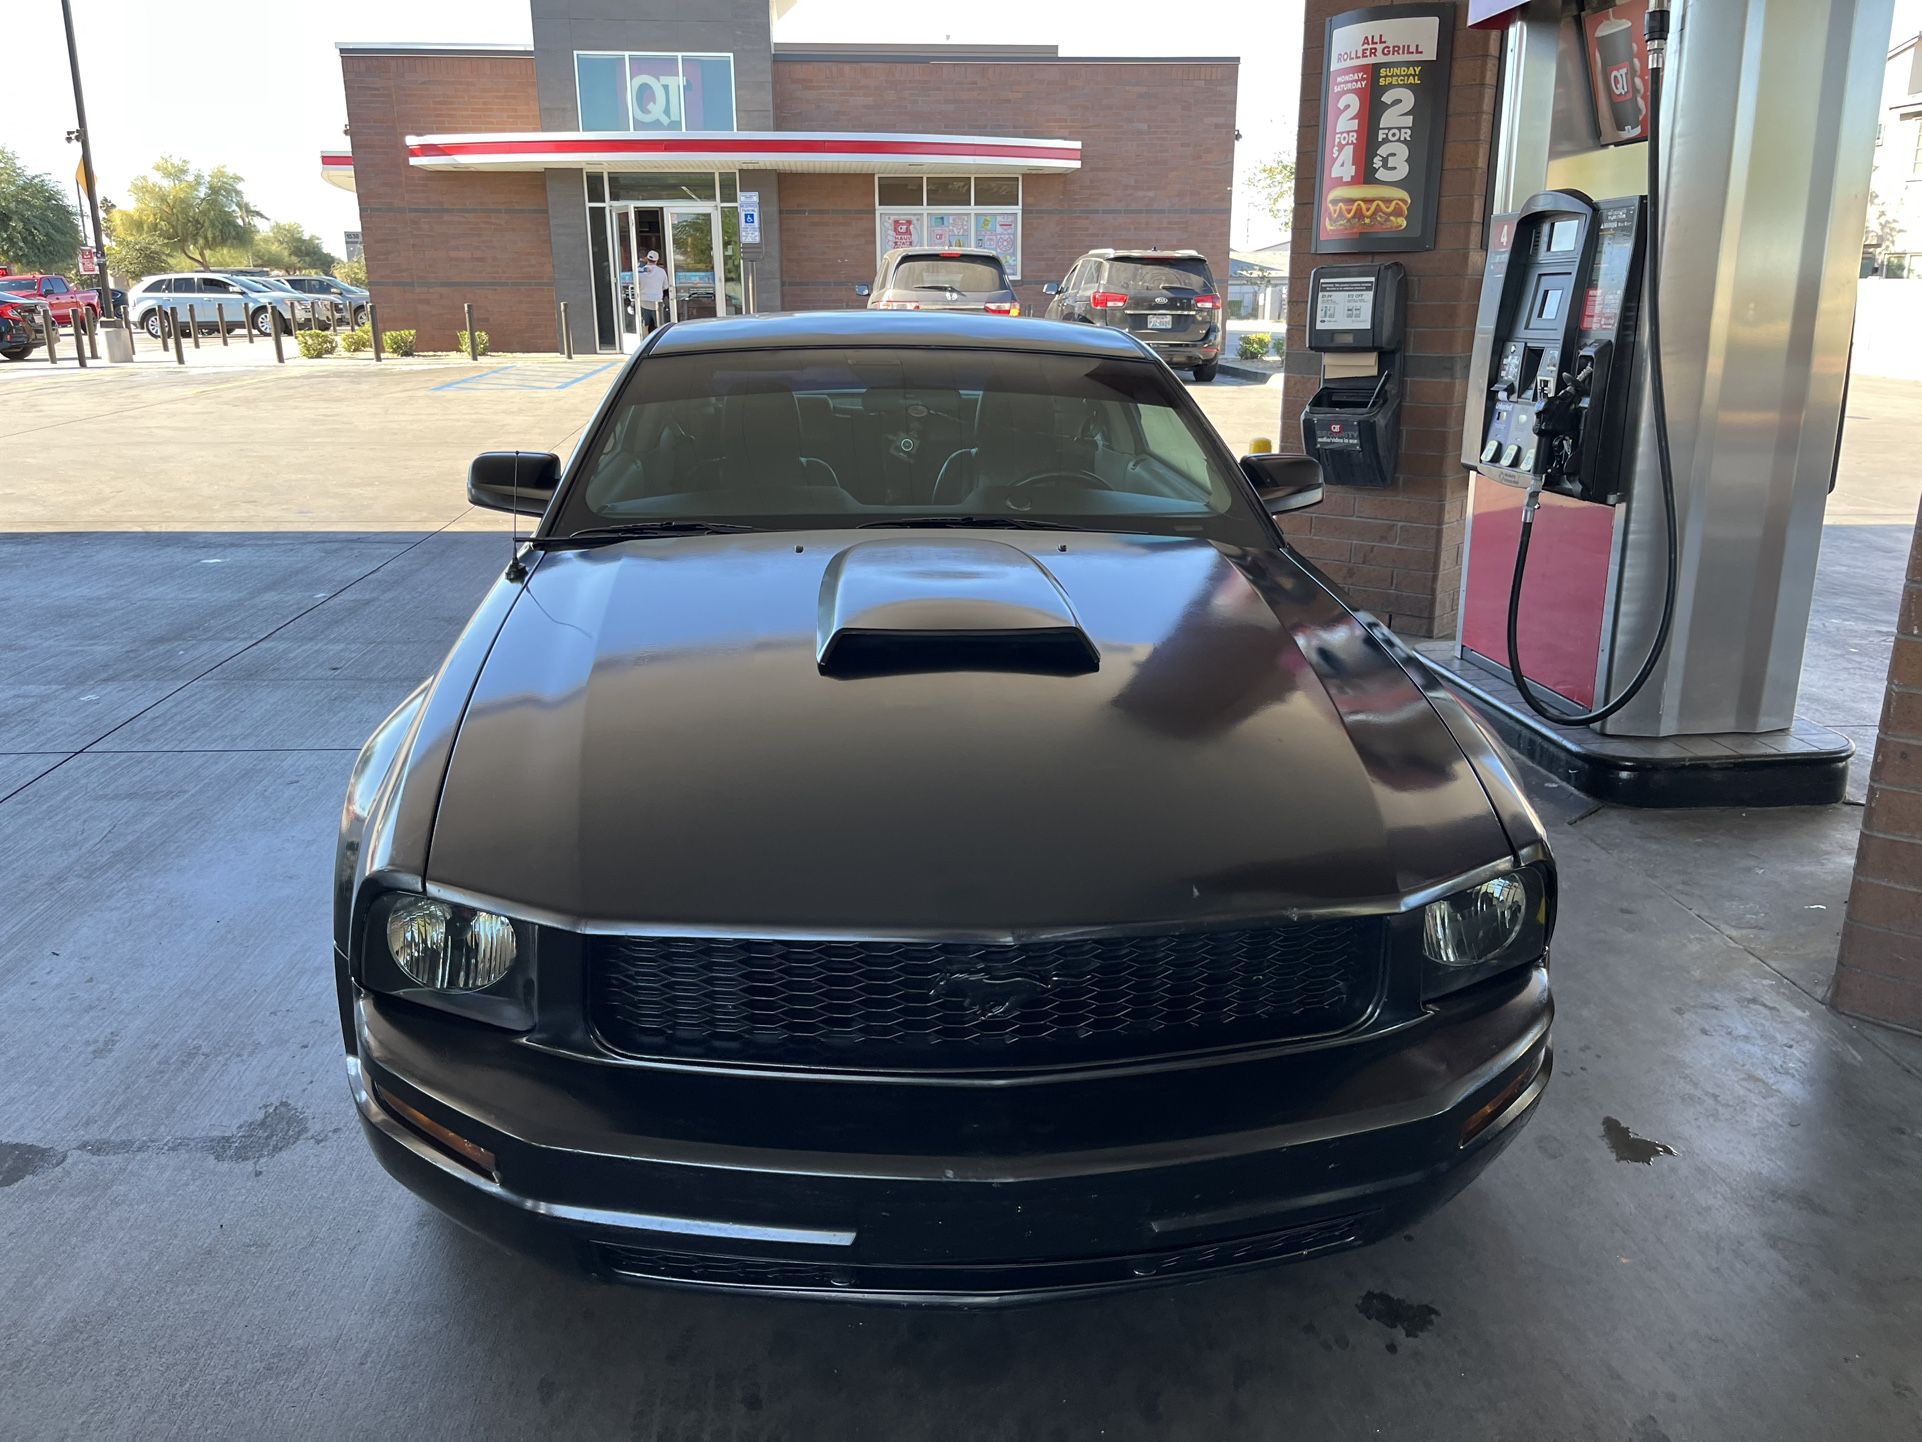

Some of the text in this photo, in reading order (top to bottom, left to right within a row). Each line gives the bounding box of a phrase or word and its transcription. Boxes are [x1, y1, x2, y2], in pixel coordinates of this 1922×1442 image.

[1361, 34, 1387, 47] ALL
[1337, 44, 1424, 63] ROLLER GRILL
[1379, 76, 1420, 85] SPECIAL
[1380, 66, 1421, 75] SUNDAY
[1611, 67, 1628, 94] QT
[1333, 81, 1367, 93] SATURDAY
[626, 74, 687, 127] QT
[1380, 88, 1414, 127] 2
[1336, 93, 1359, 132] 2
[1334, 132, 1357, 145] FOR
[1378, 129, 1410, 141] FOR
[1331, 145, 1356, 182] $4
[1372, 142, 1410, 182] $3
[1500, 224, 1508, 246] 4
